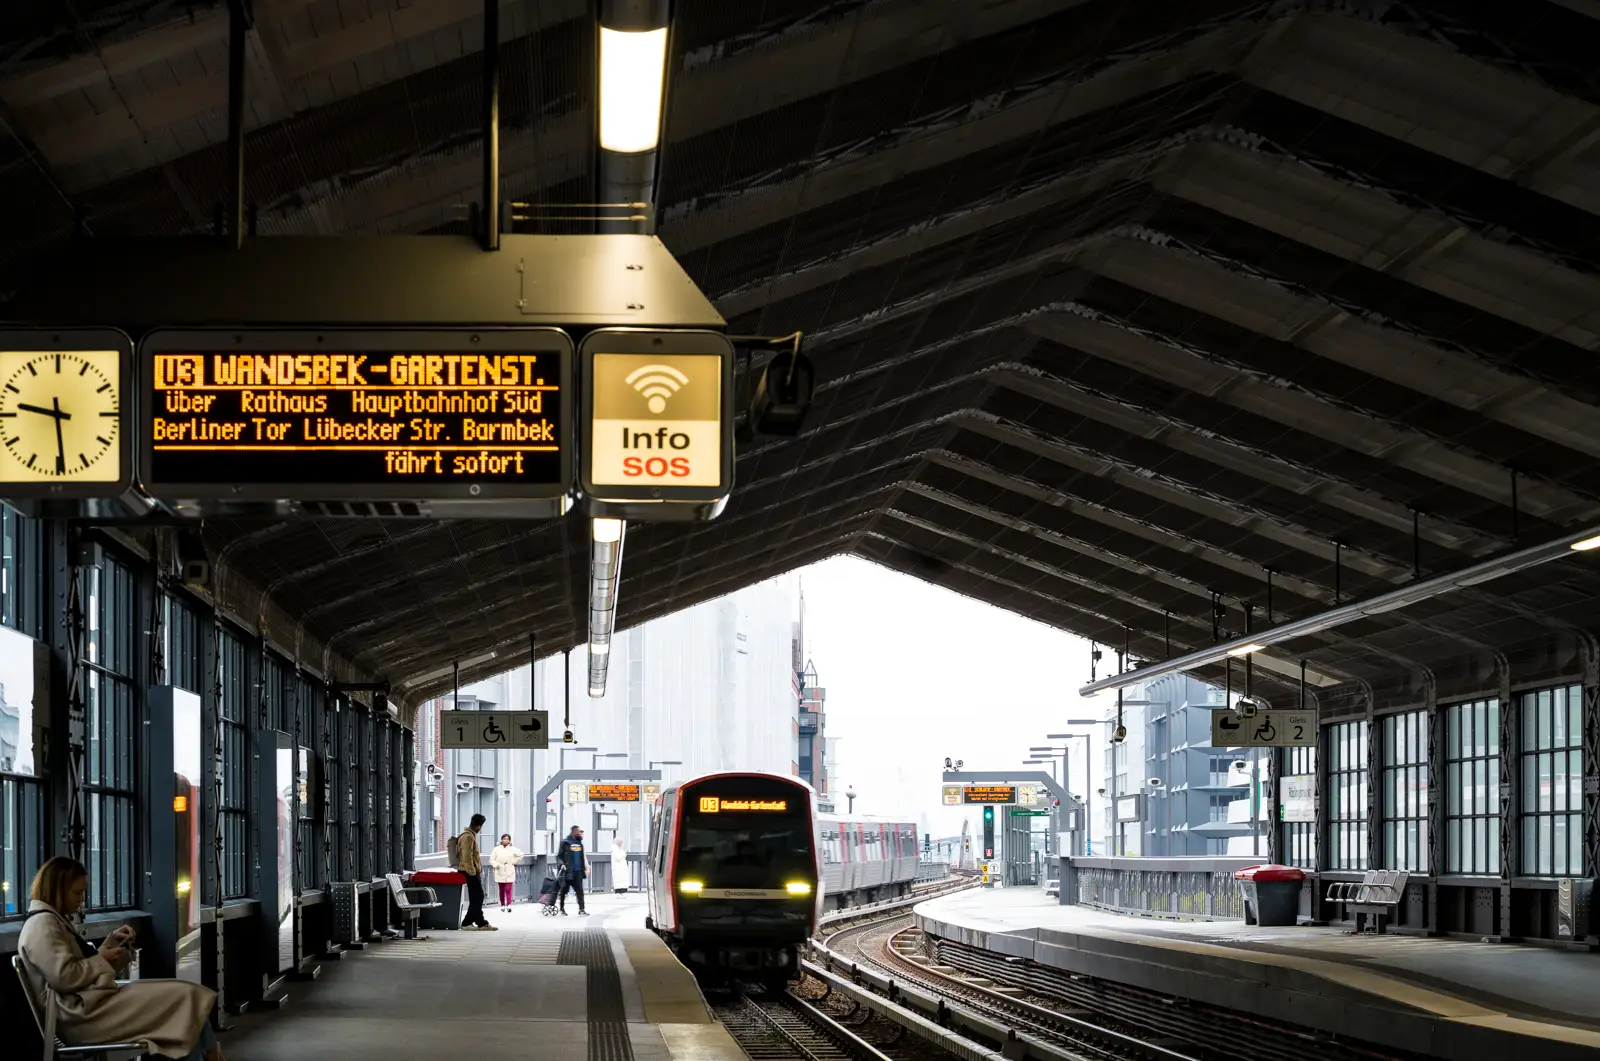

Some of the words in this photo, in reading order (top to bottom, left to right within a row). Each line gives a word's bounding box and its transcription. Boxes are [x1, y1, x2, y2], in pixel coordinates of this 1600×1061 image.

[156, 355, 202, 387] U3
[214, 355, 545, 386] WANDSBEK-GARTENST.
[166, 391, 217, 413] über
[241, 391, 327, 413] Rathaus
[352, 391, 499, 417] Hauptbahnhof
[503, 391, 542, 413] Süd
[153, 418, 247, 441] Berliner
[252, 418, 292, 441] Tor
[304, 418, 405, 441] Lübecker
[410, 418, 451, 441] Str.
[463, 418, 554, 441] Barmbek
[622, 427, 691, 450] Info
[384, 451, 443, 474] fährt
[452, 451, 524, 474] sofort
[622, 456, 691, 477] SOS
[451, 717, 469, 725] Gleis
[1289, 716, 1307, 724] Gleis
[456, 727, 463, 742] 1
[1293, 725, 1304, 740] 2
[701, 798, 718, 811] U3
